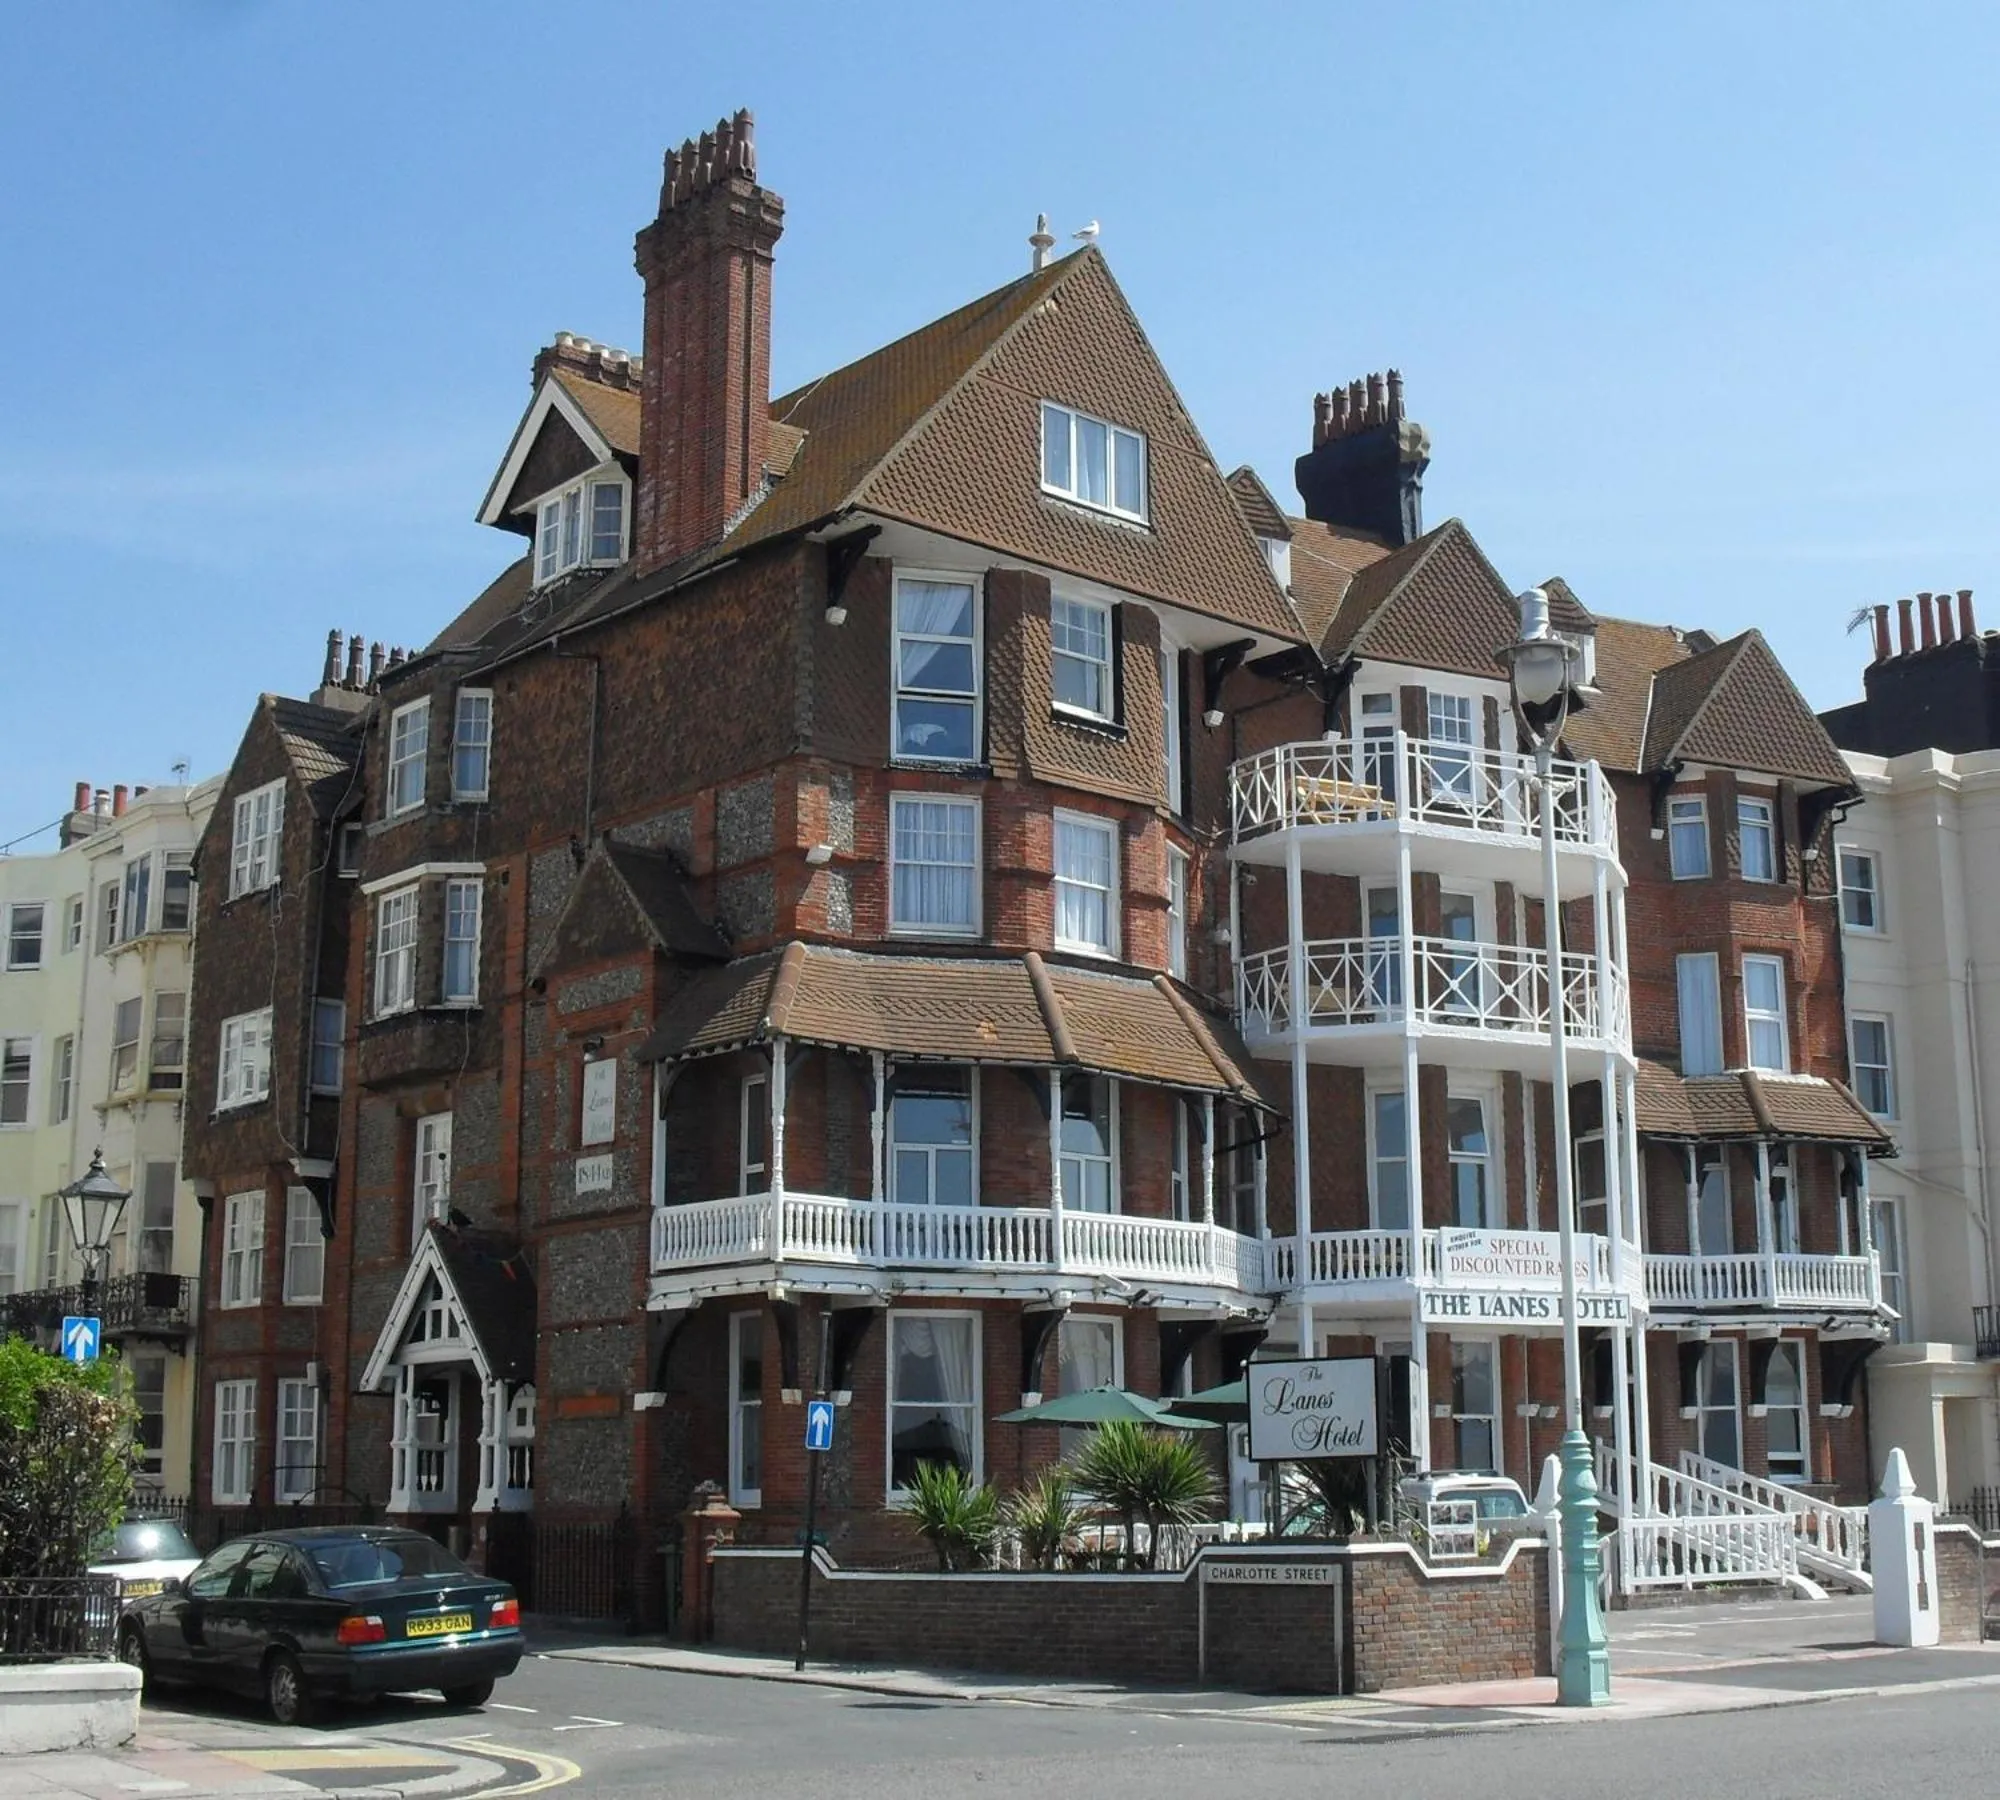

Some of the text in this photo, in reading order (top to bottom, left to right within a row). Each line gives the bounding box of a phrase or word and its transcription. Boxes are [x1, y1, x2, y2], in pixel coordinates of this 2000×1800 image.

[1490, 1239, 1549, 1256] SPECIAL
[1450, 1256, 1589, 1277] DISCOUNTED RAES
[1425, 1293, 1471, 1316] THE
[1479, 1295, 1549, 1318] LANES
[1300, 1365, 1323, 1382] The
[1263, 1377, 1335, 1416] Lanes
[1291, 1414, 1364, 1453] Hotel
[1211, 1567, 1328, 1580] CHARLOTTE STREET
